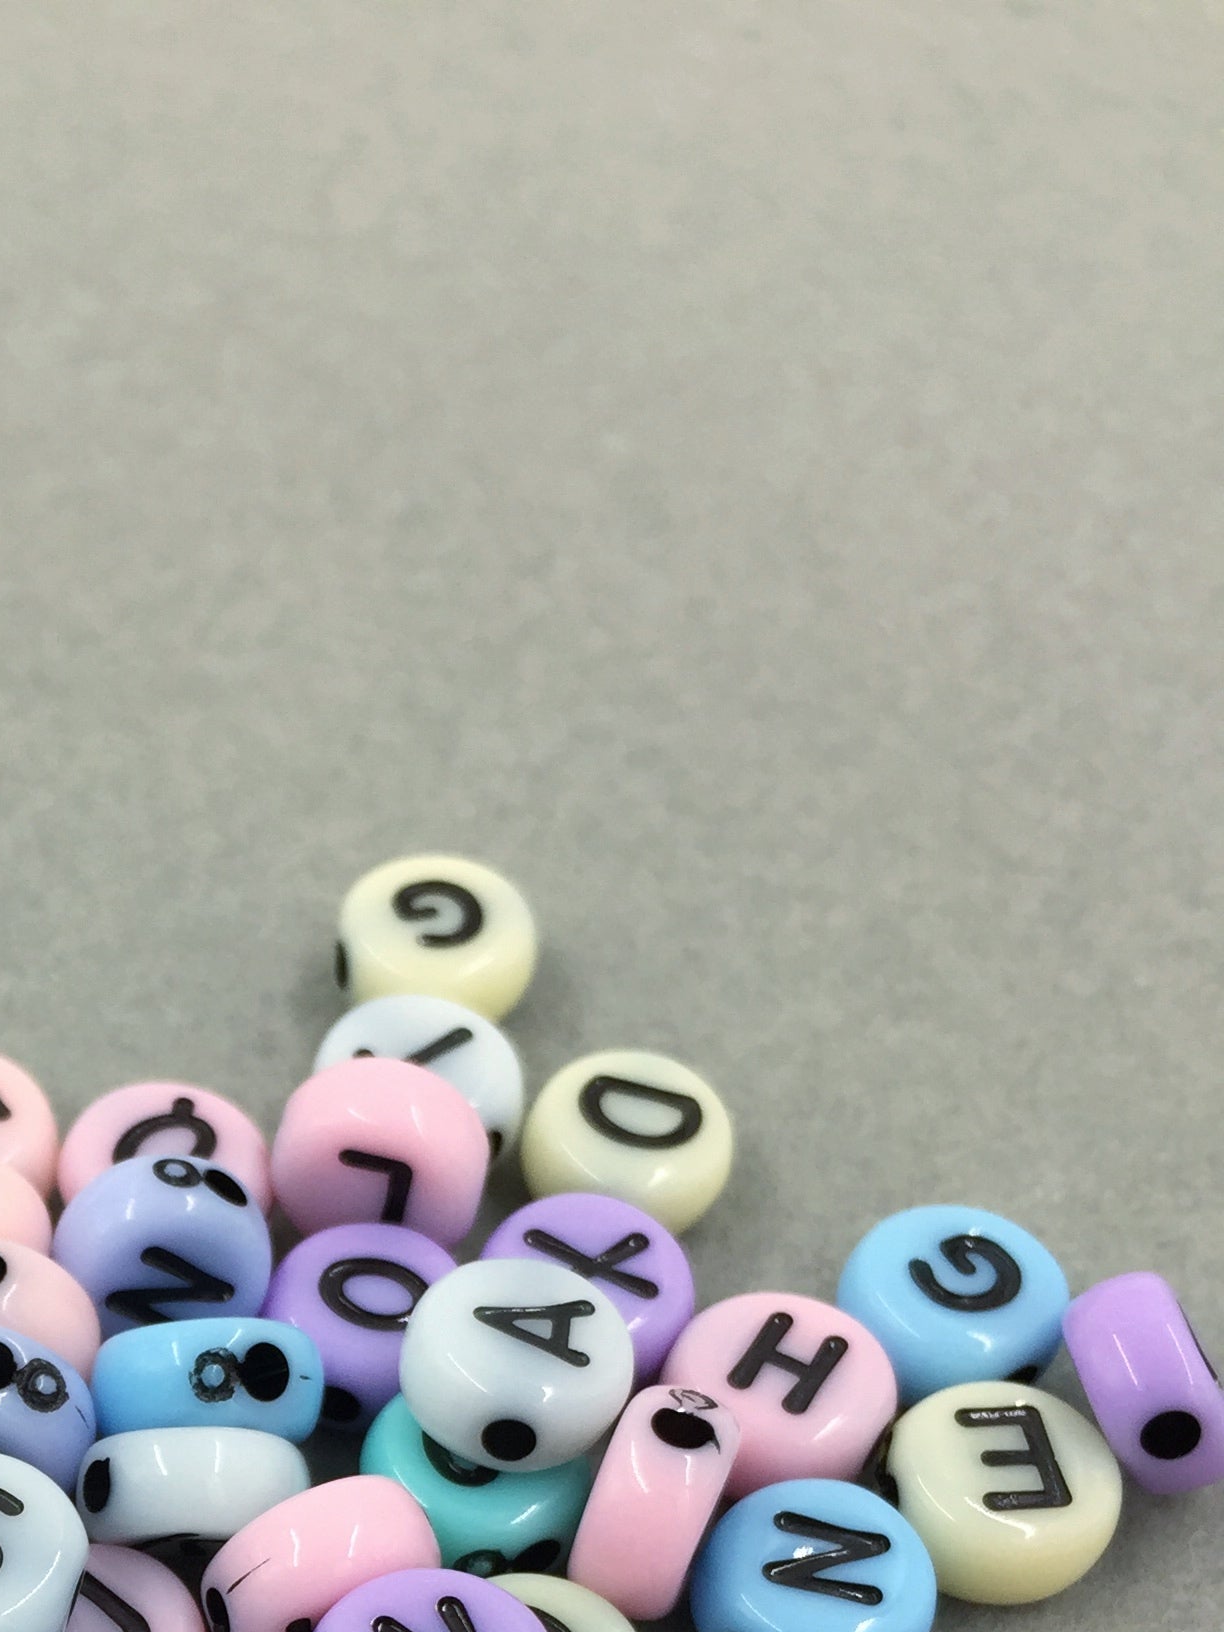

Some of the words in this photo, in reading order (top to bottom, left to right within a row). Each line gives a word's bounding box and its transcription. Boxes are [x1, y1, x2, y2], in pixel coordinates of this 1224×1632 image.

[393, 880, 481, 945] G
[908, 1235, 1023, 1313] G
[473, 1299, 596, 1368] A
[727, 1311, 849, 1415] H
[954, 1404, 1074, 1512] E
[761, 1510, 892, 1606] N
